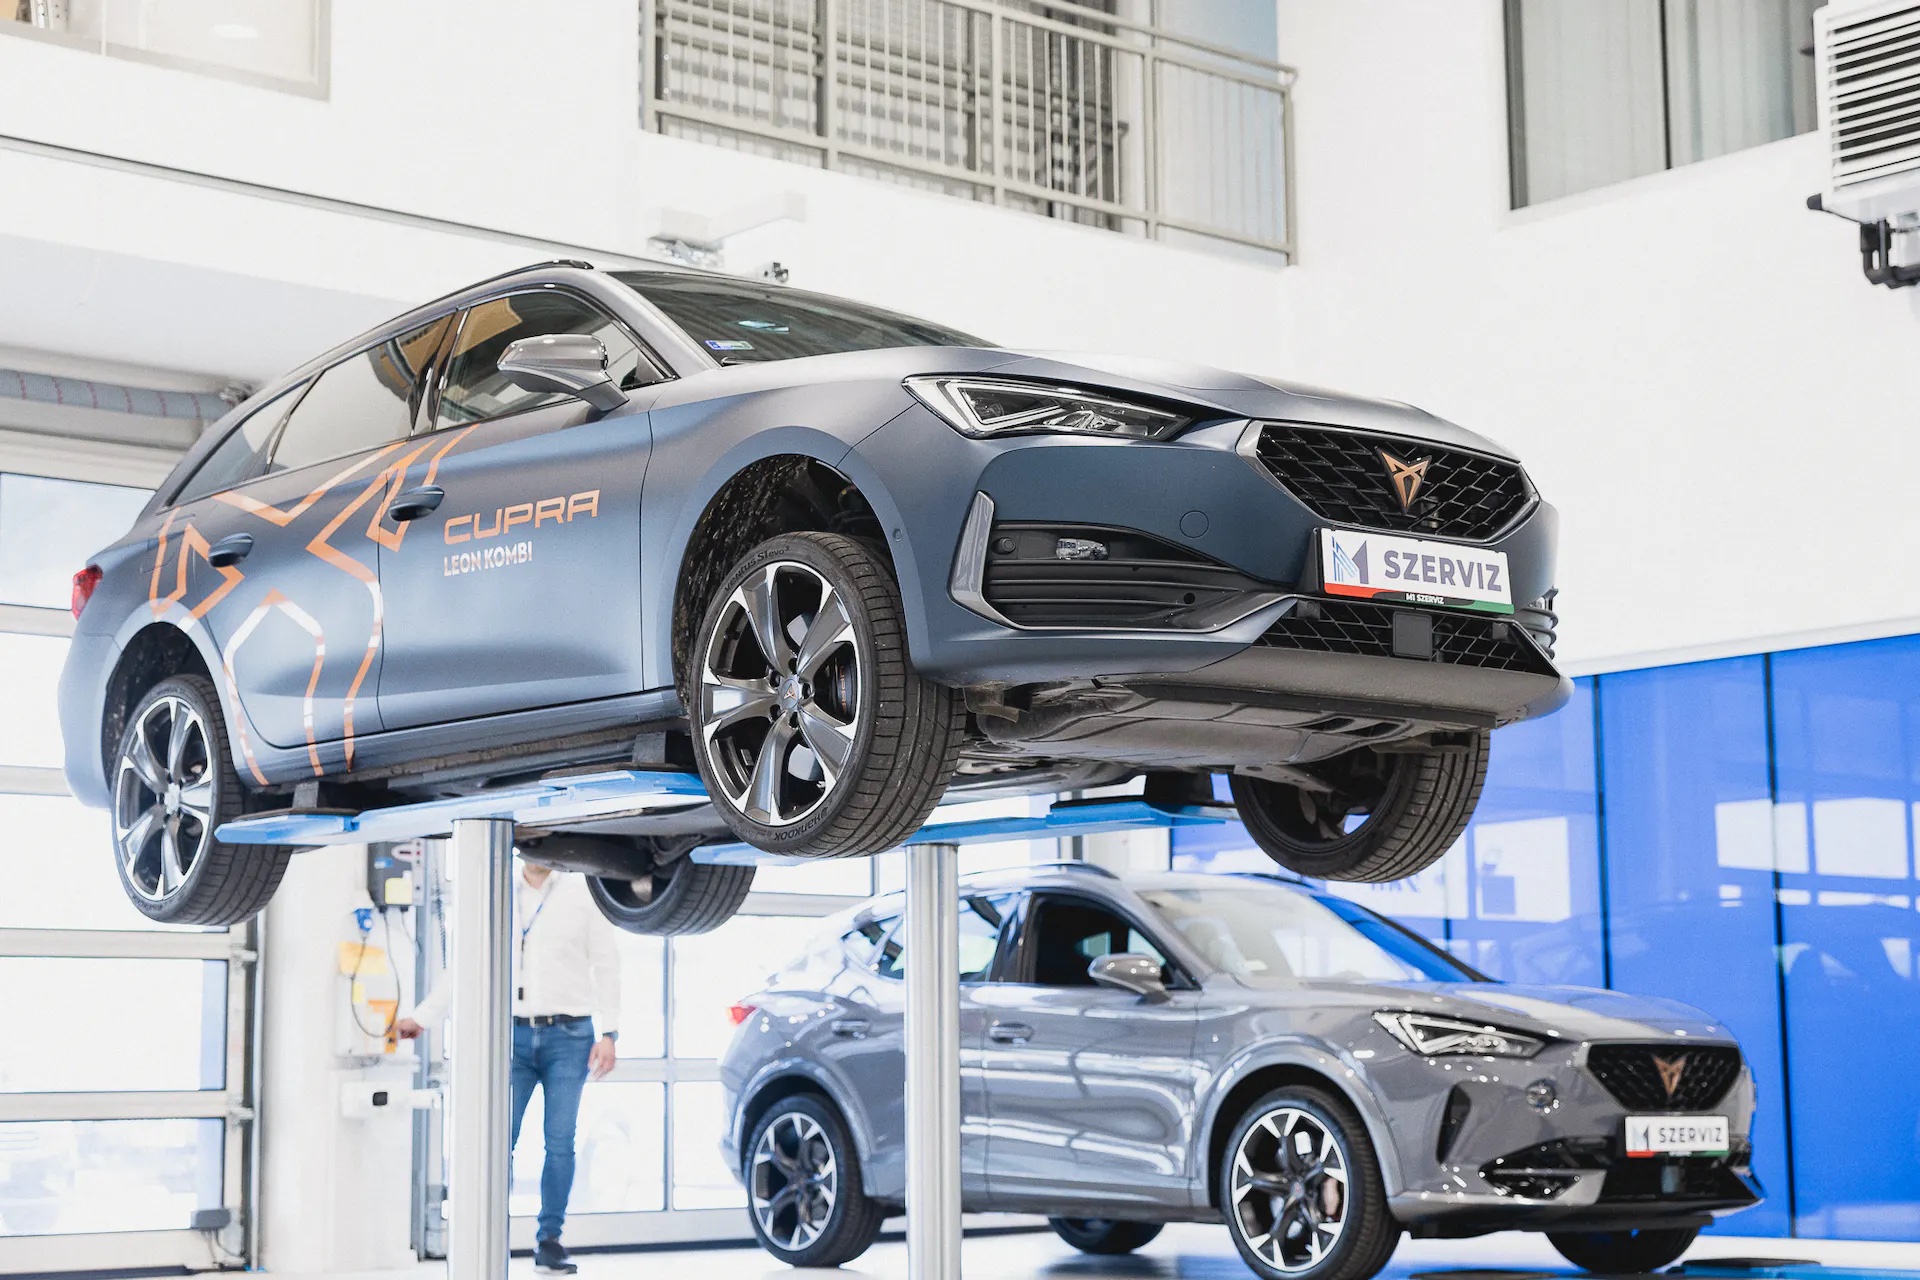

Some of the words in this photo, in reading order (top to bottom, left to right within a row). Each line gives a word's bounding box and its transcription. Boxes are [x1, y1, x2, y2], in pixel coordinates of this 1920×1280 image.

[443, 489, 600, 545] CUPRA
[443, 550, 482, 577] LEON
[484, 540, 533, 570] KOMBI
[1384, 550, 1502, 592] SZERVIZ
[1405, 592, 1416, 601] M1
[1416, 594, 1445, 605] SZERVIZ
[1659, 1126, 1722, 1143] SZERVIZ
